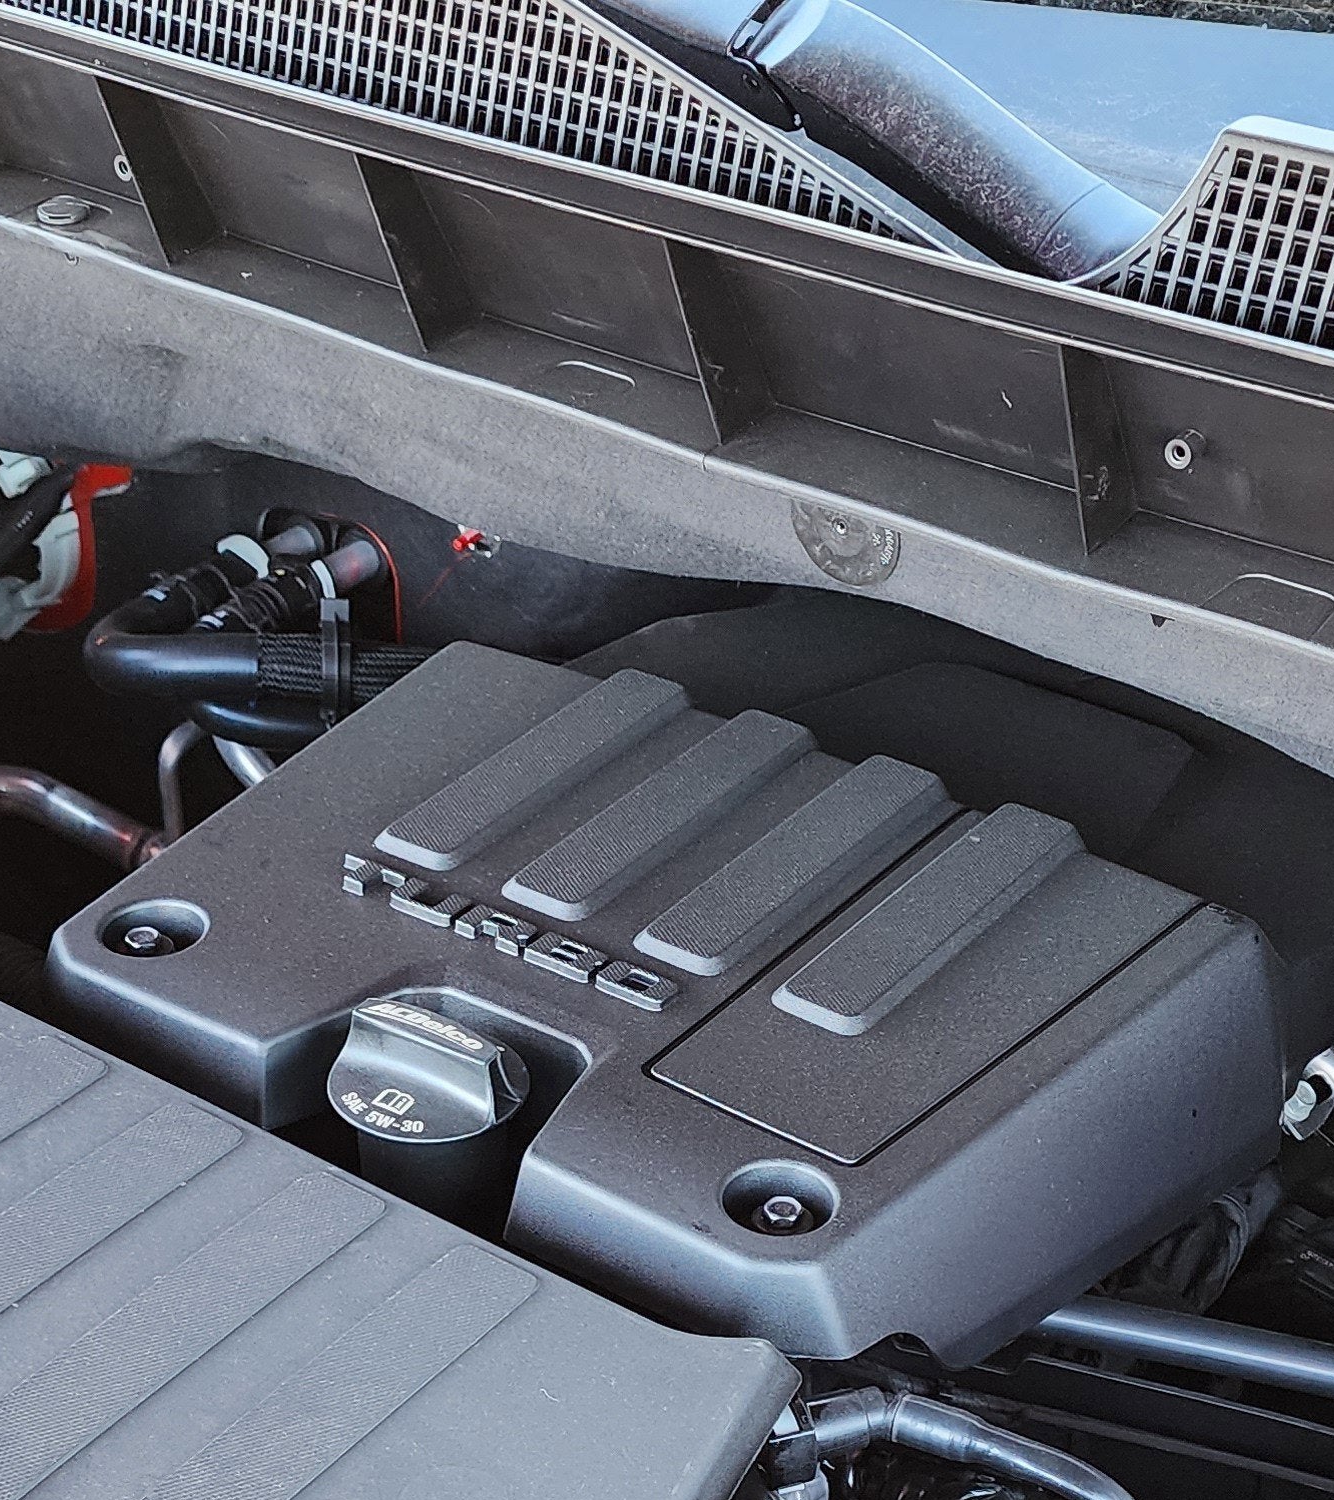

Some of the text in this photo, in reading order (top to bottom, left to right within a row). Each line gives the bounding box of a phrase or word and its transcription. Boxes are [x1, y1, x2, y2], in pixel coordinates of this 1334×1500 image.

[342, 853, 679, 1012] TURBO
[367, 1002, 484, 1051] ACDelco
[341, 1090, 425, 1134] SAE 5W-30
